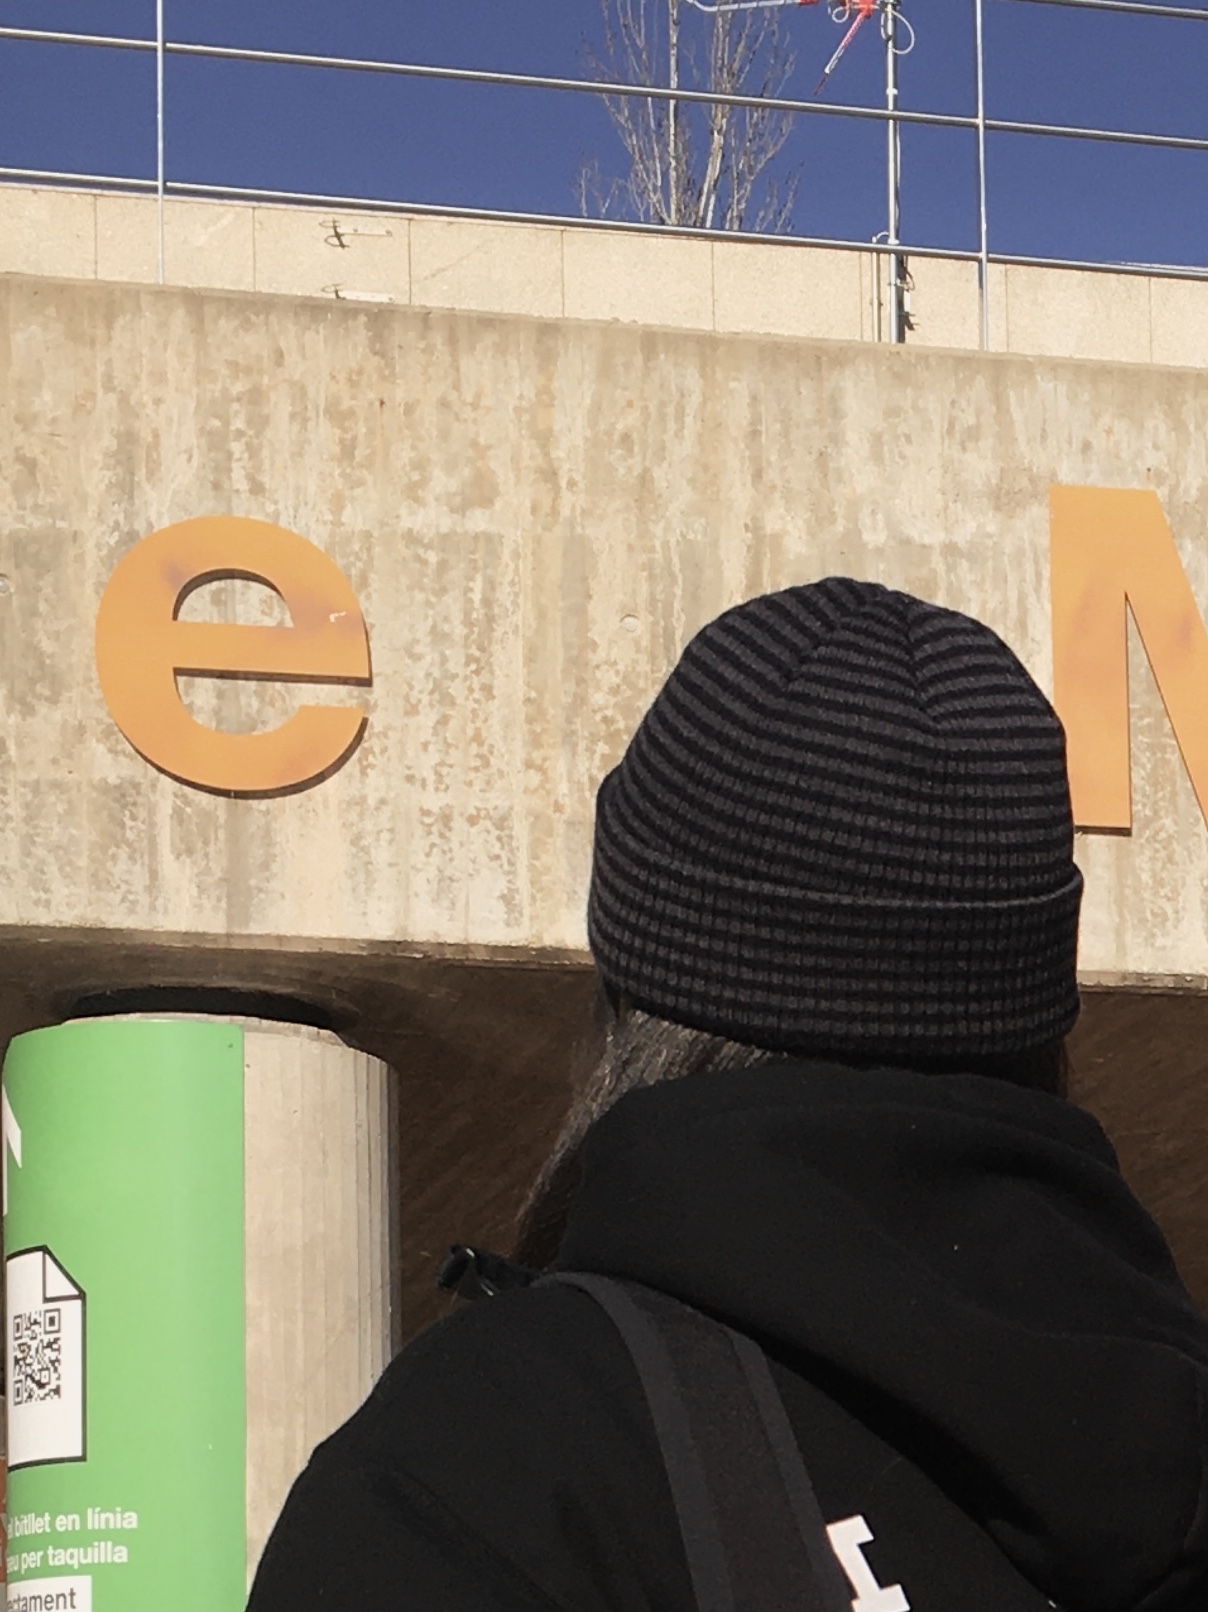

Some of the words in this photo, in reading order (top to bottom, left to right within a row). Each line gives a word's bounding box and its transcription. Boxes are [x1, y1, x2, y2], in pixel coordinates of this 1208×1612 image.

[55, 1513, 81, 1532] en
[87, 1507, 138, 1530] línia
[21, 1550, 44, 1574] per
[47, 1541, 128, 1569] taquilla
